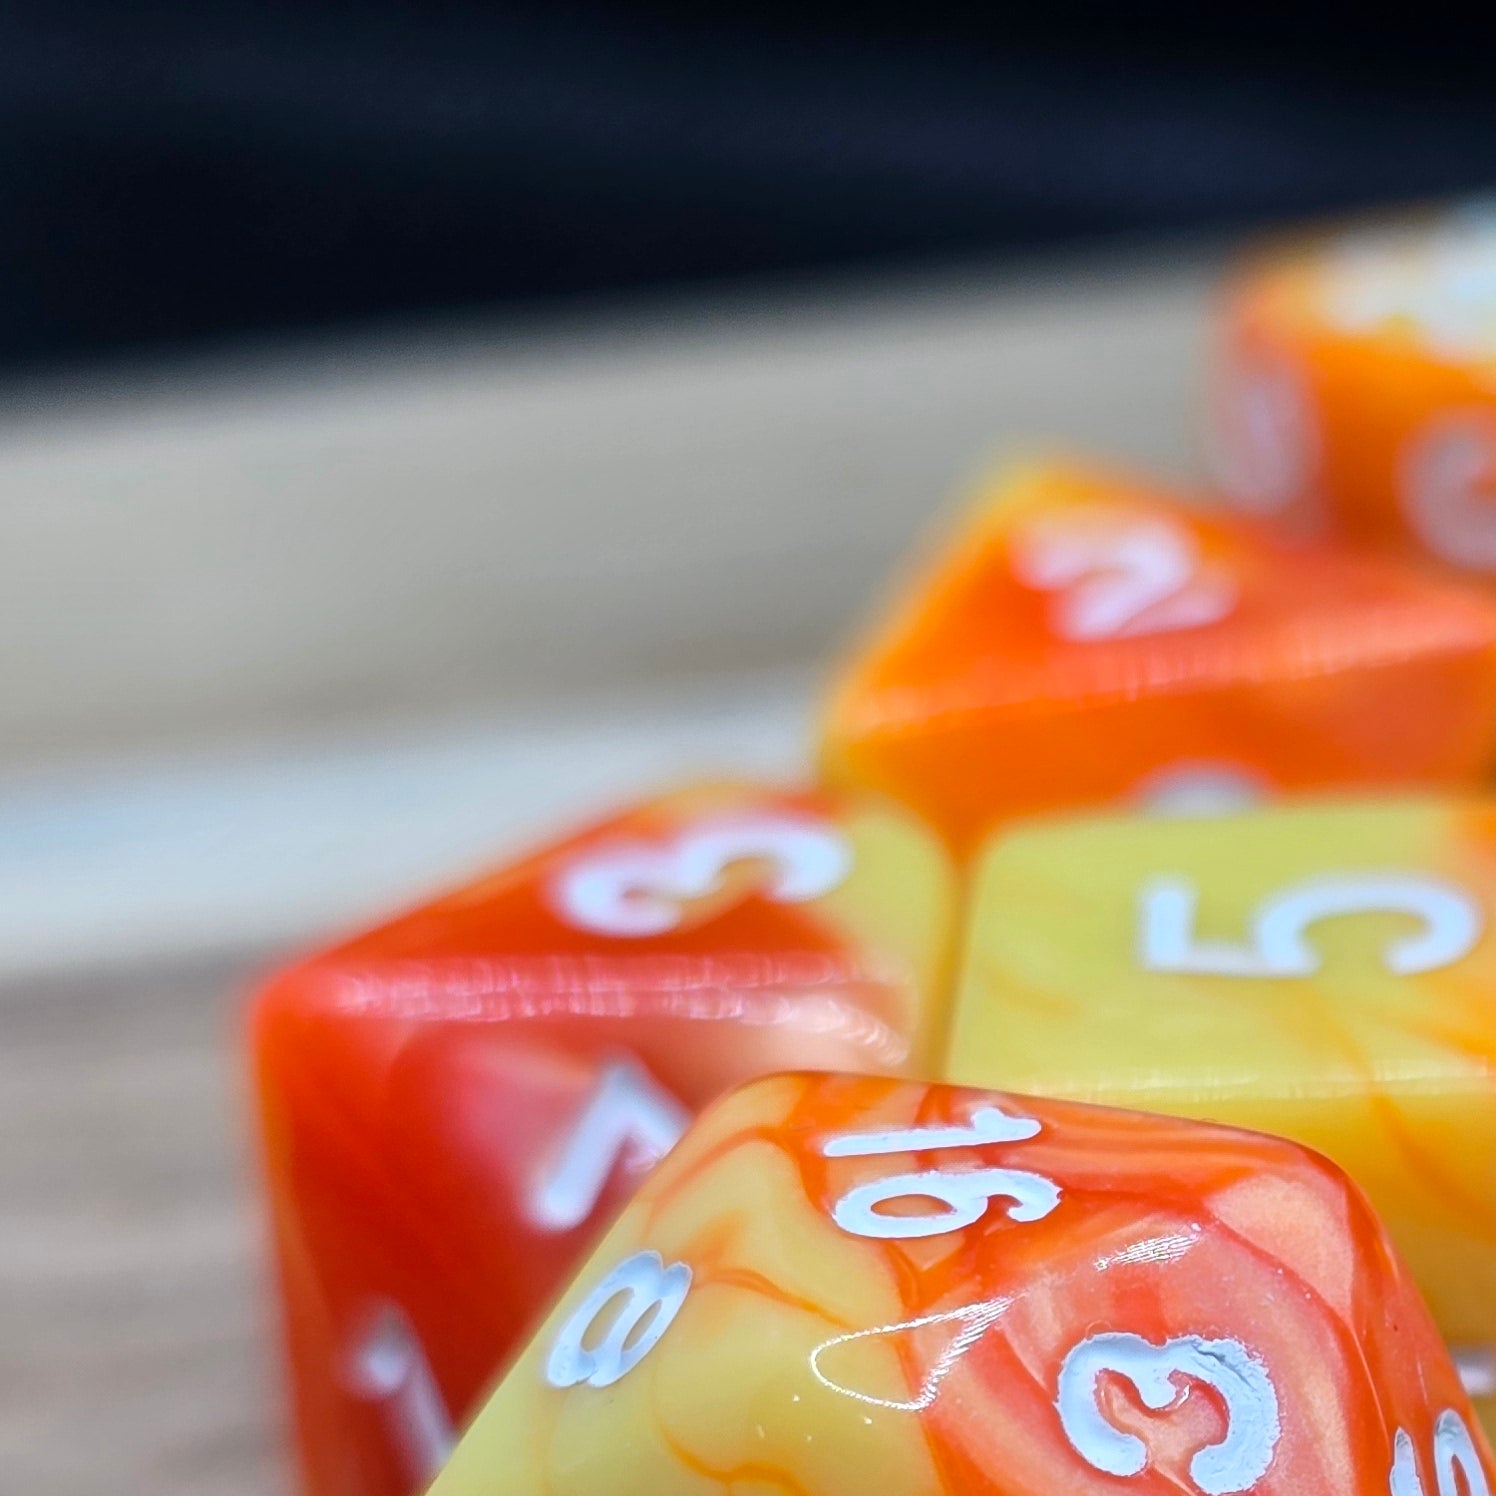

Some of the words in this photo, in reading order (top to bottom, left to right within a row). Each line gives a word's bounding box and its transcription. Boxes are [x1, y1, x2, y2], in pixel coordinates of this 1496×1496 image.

[560, 813, 848, 936] 3
[1135, 868, 1481, 980] 5
[820, 1105, 1064, 1240] 16
[545, 1249, 694, 1389] 8
